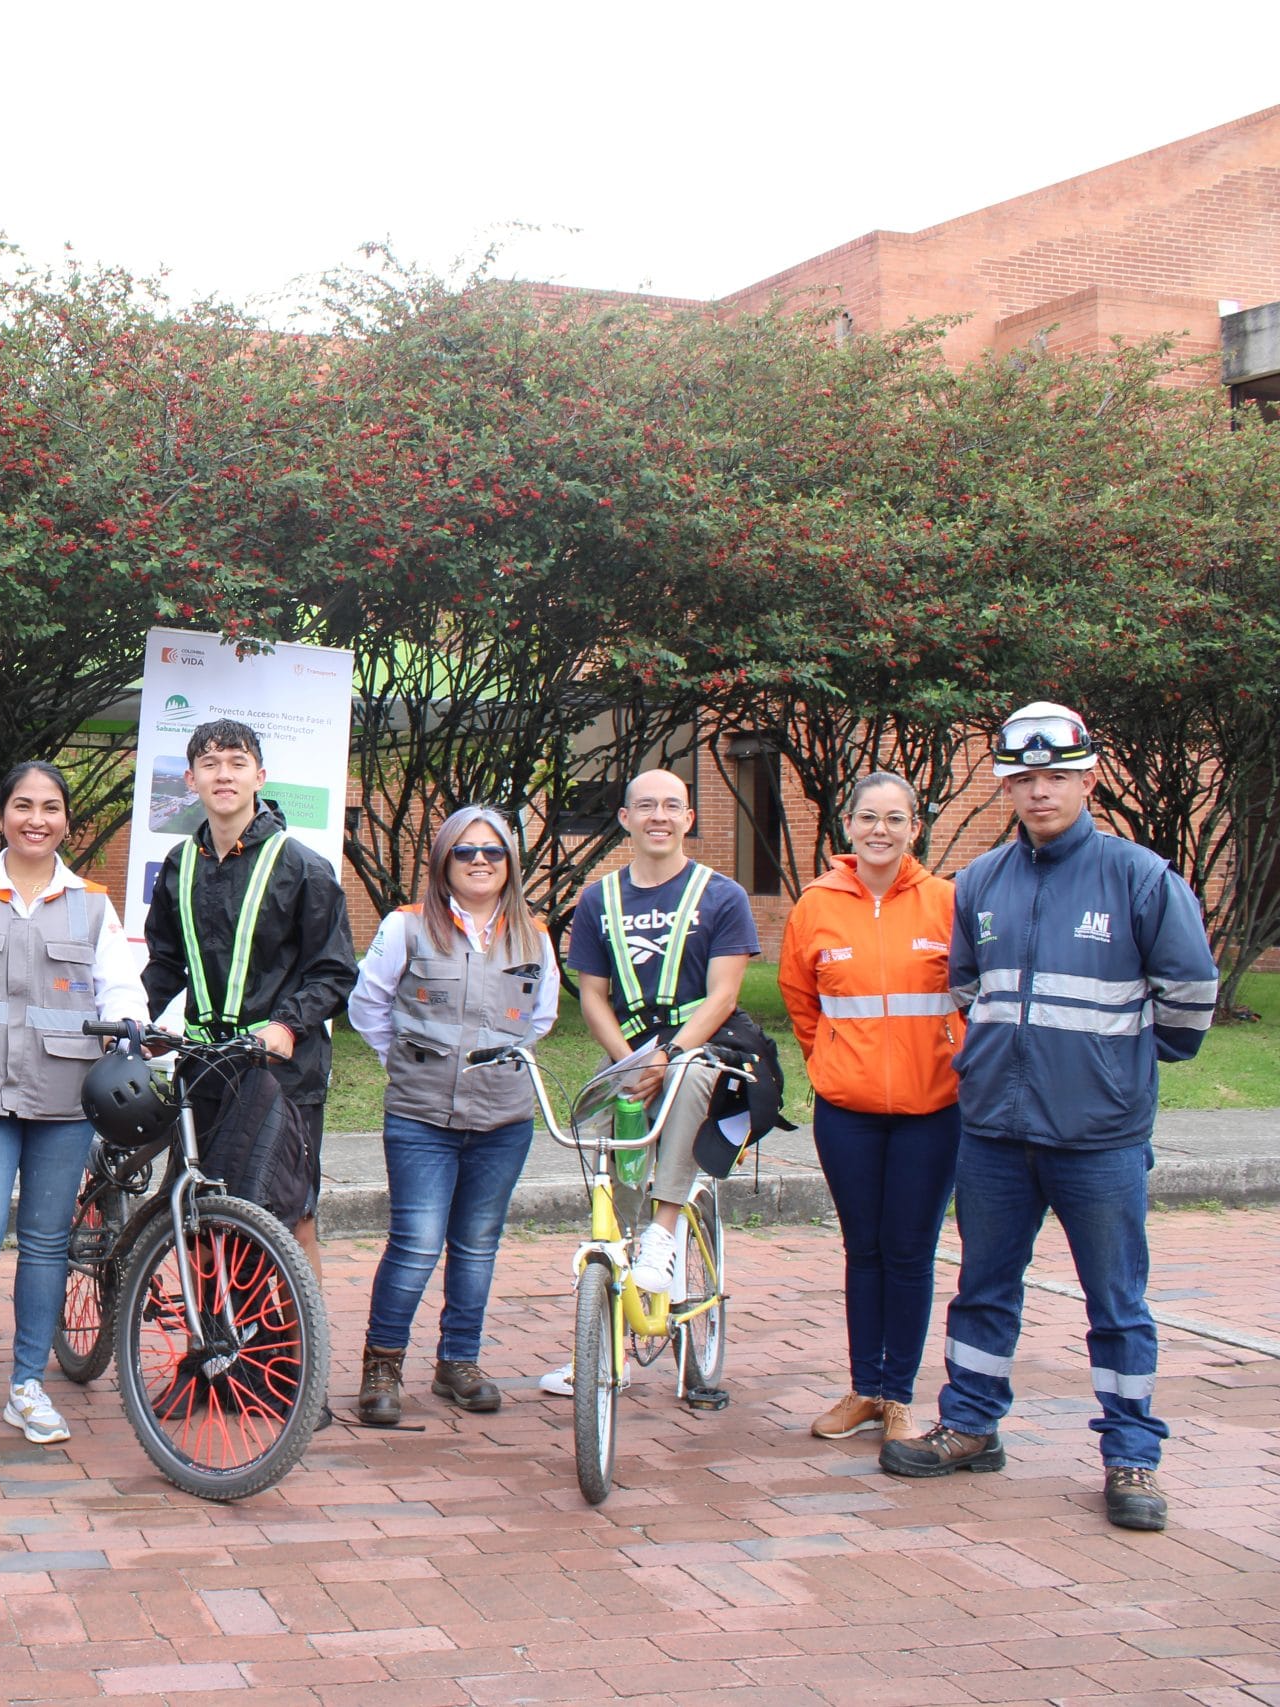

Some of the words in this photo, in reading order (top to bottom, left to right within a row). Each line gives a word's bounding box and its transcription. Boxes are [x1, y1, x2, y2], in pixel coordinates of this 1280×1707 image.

[181, 657, 204, 666] VIDA
[209, 705, 245, 716] Proyecto
[247, 709, 280, 719] Accesos
[281, 712, 304, 721] Norte
[306, 715, 325, 724] Fase
[267, 722, 314, 734] Constructor
[274, 732, 297, 742] Norte
